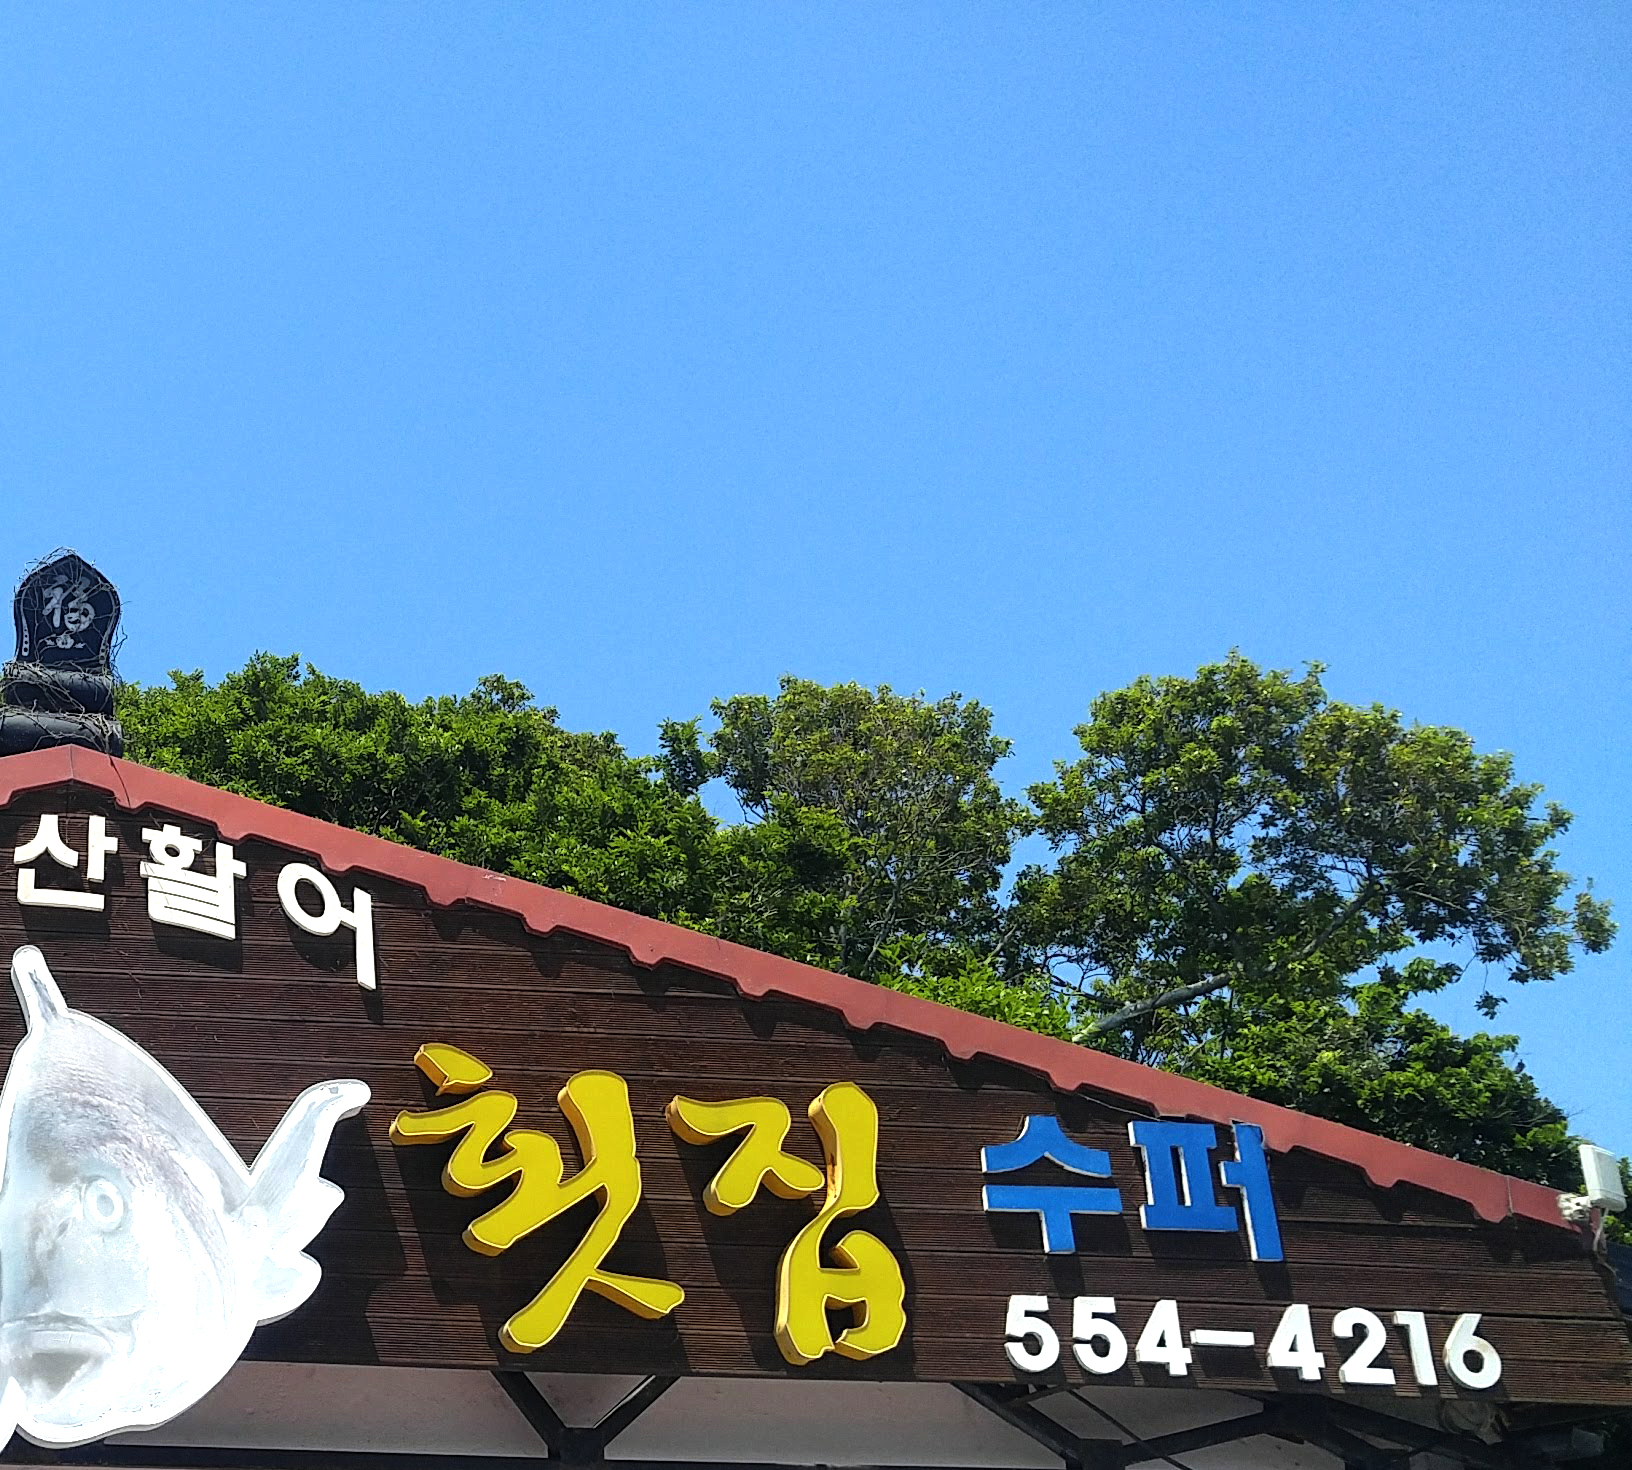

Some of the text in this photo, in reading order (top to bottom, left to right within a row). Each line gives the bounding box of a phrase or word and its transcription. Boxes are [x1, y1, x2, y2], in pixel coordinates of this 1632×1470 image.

[42, 574, 96, 633] 福
[389, 1043, 907, 1365] 횟집
[980, 1114, 1284, 1262] 수퍼
[1004, 1294, 1502, 1390] 554-4216
